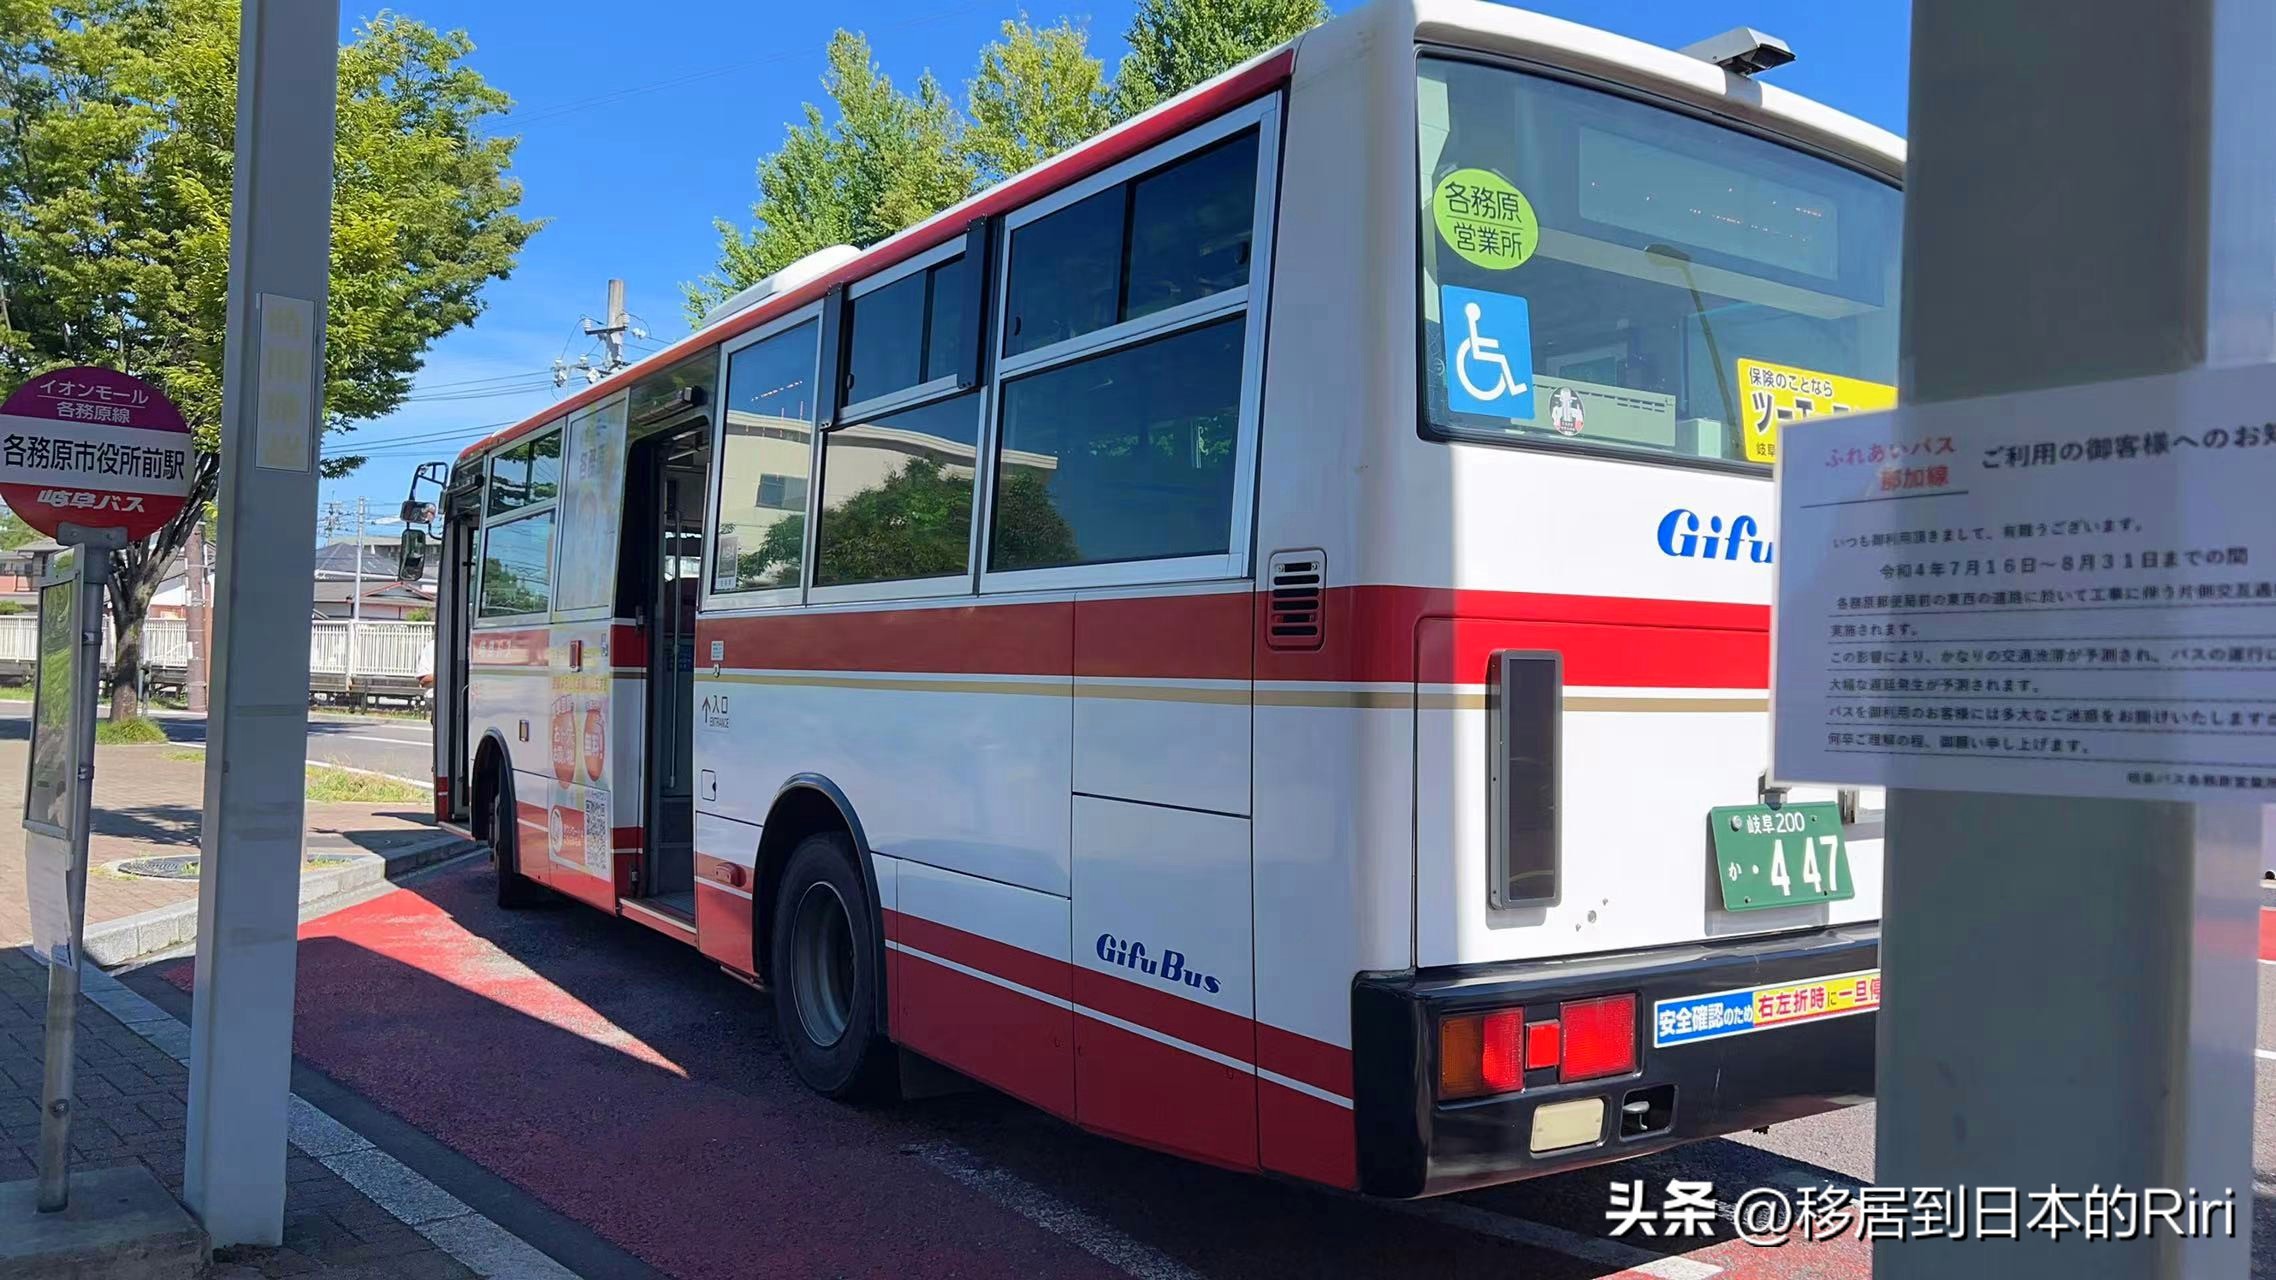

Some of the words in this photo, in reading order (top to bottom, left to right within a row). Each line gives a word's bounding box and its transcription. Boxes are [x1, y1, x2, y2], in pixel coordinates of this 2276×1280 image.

[1445, 181, 1522, 223] 各務原
[1454, 221, 1522, 261] 営業所
[39, 379, 149, 405] イオンモール
[1749, 366, 1833, 397] 保険のことなら
[57, 402, 131, 424] 各務原線
[3, 433, 185, 481] 各務原市役所前駅
[1824, 436, 1955, 468] ふれあいバス
[37, 489, 145, 513] 岐阜バス
[1657, 508, 1775, 564] Gifu
[712, 695, 728, 714] 入口
[1747, 812, 1805, 834] 岐阜200
[1659, 1002, 1753, 1037] 安全確認のため
